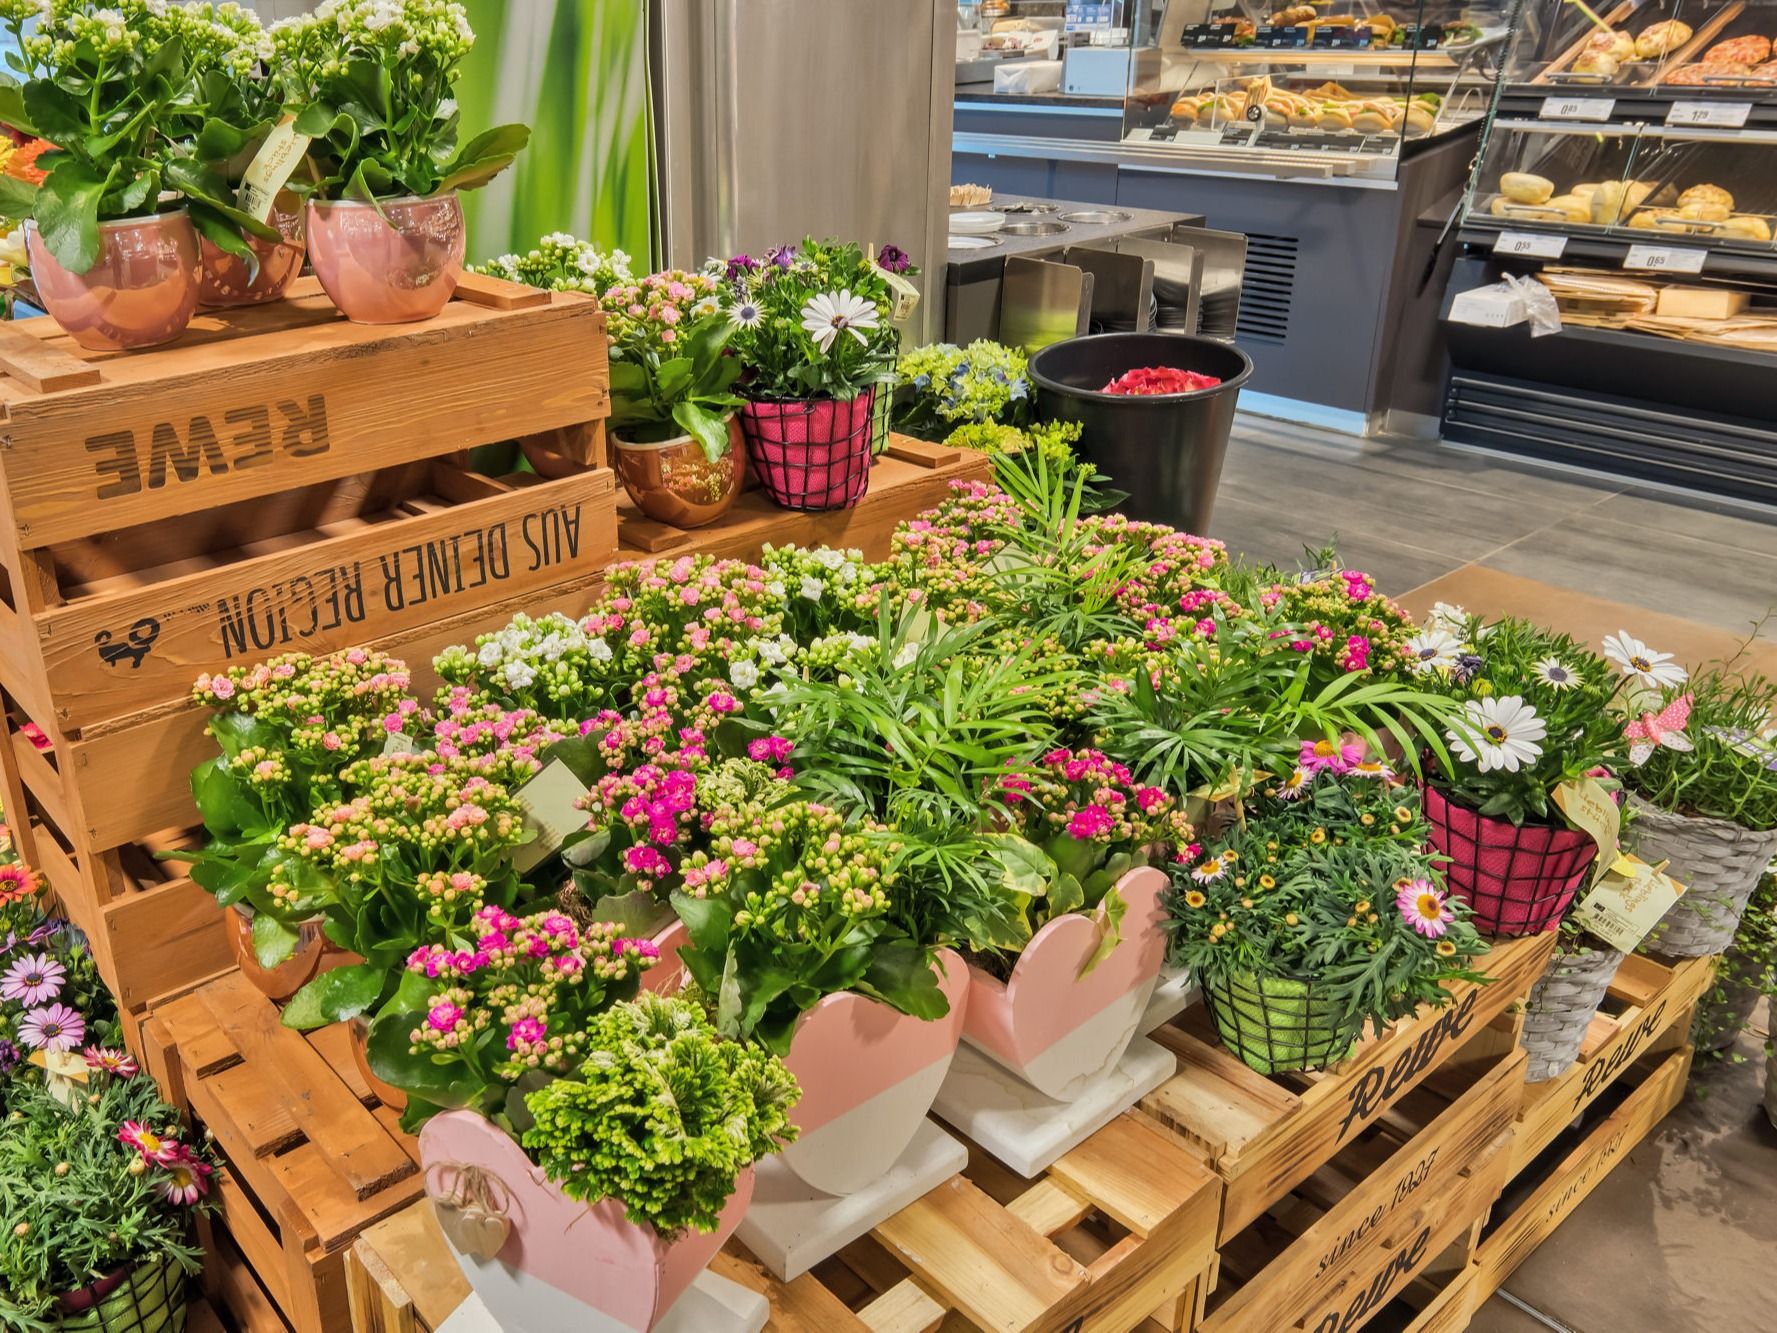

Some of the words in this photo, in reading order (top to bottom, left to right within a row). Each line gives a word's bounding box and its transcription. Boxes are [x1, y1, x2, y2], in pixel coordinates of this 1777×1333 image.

[85, 394, 330, 500] REWE
[380, 523, 510, 612] DEINER
[522, 503, 582, 571] AUS
[217, 562, 366, 659] REGION
[1335, 988, 1477, 1146] Rewe
[1571, 999, 1667, 1114] Rewe
[1315, 1203, 1387, 1279] since
